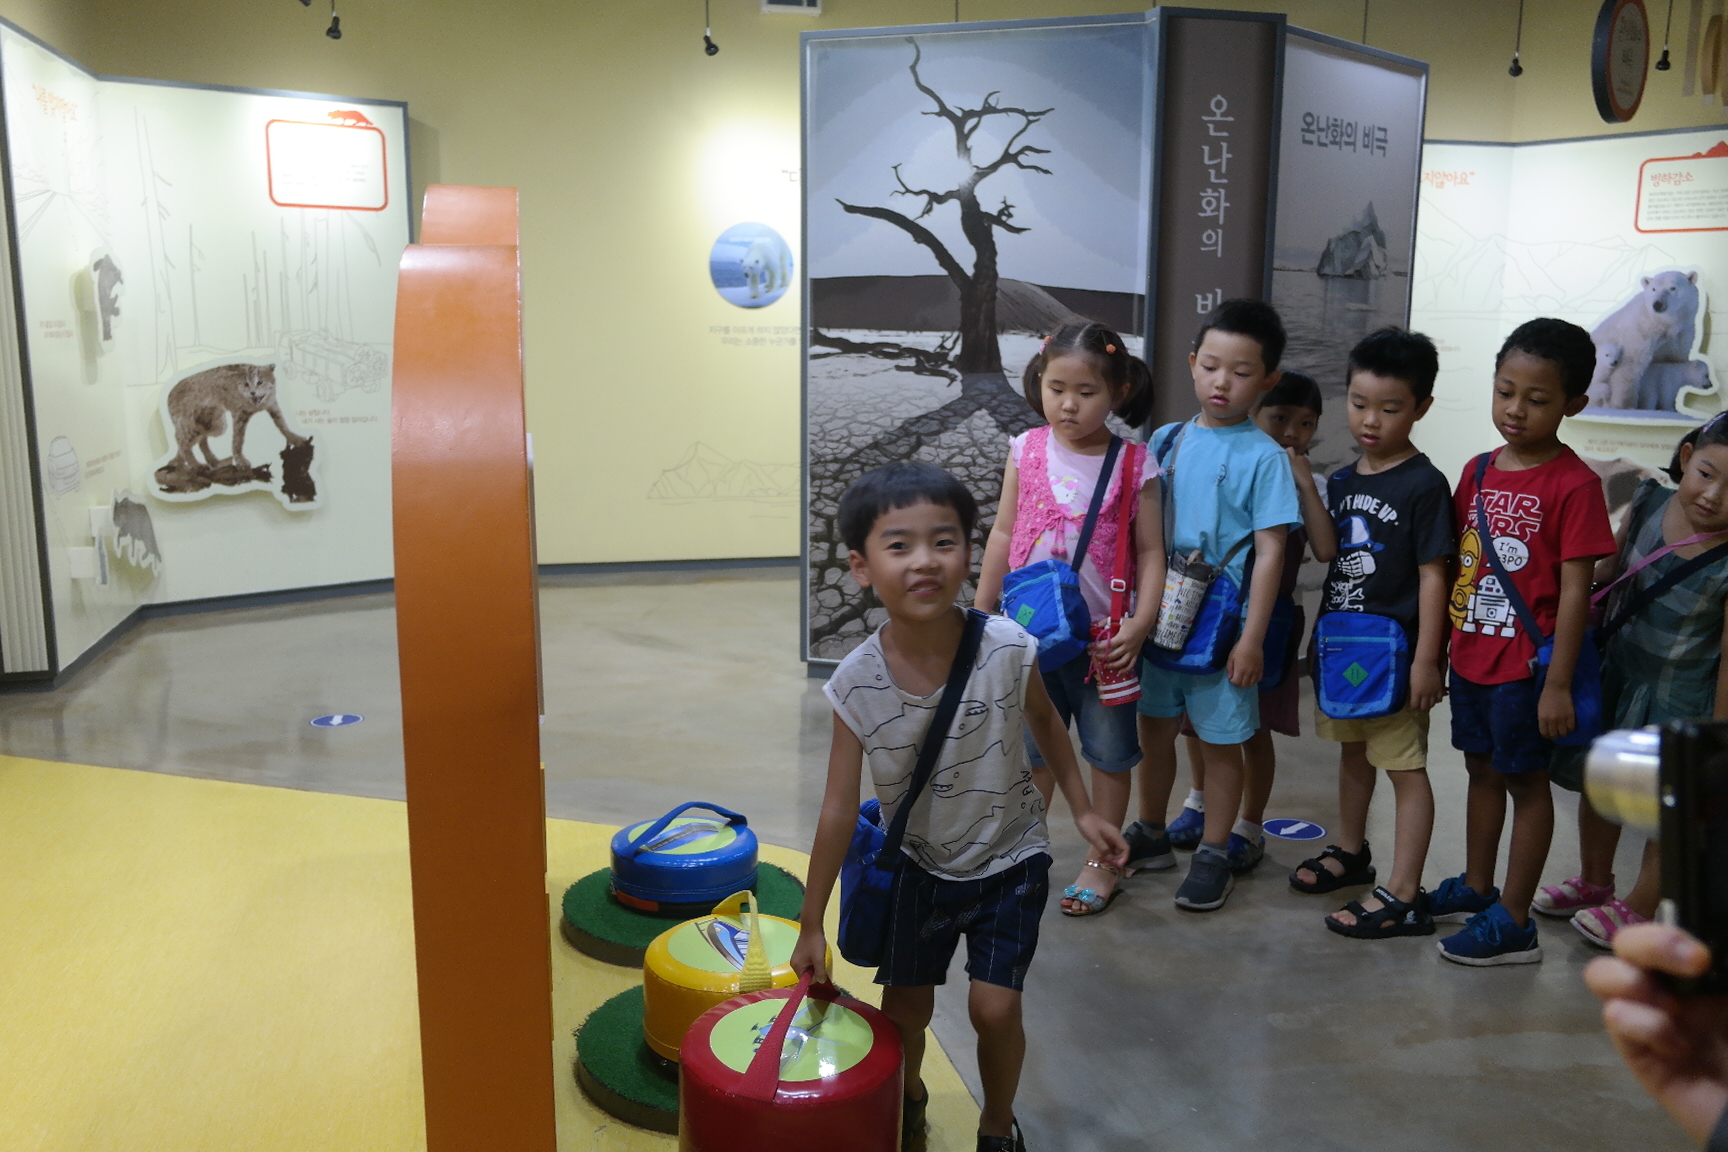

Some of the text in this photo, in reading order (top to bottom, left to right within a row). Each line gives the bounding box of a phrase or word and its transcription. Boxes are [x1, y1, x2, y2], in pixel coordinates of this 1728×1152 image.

[1300, 111, 1389, 158] 온난화의 비극
[1197, 94, 1235, 259] 온난화의
[1650, 171, 1694, 187] 빙하감소
[1352, 493, 1381, 514] HIDE
